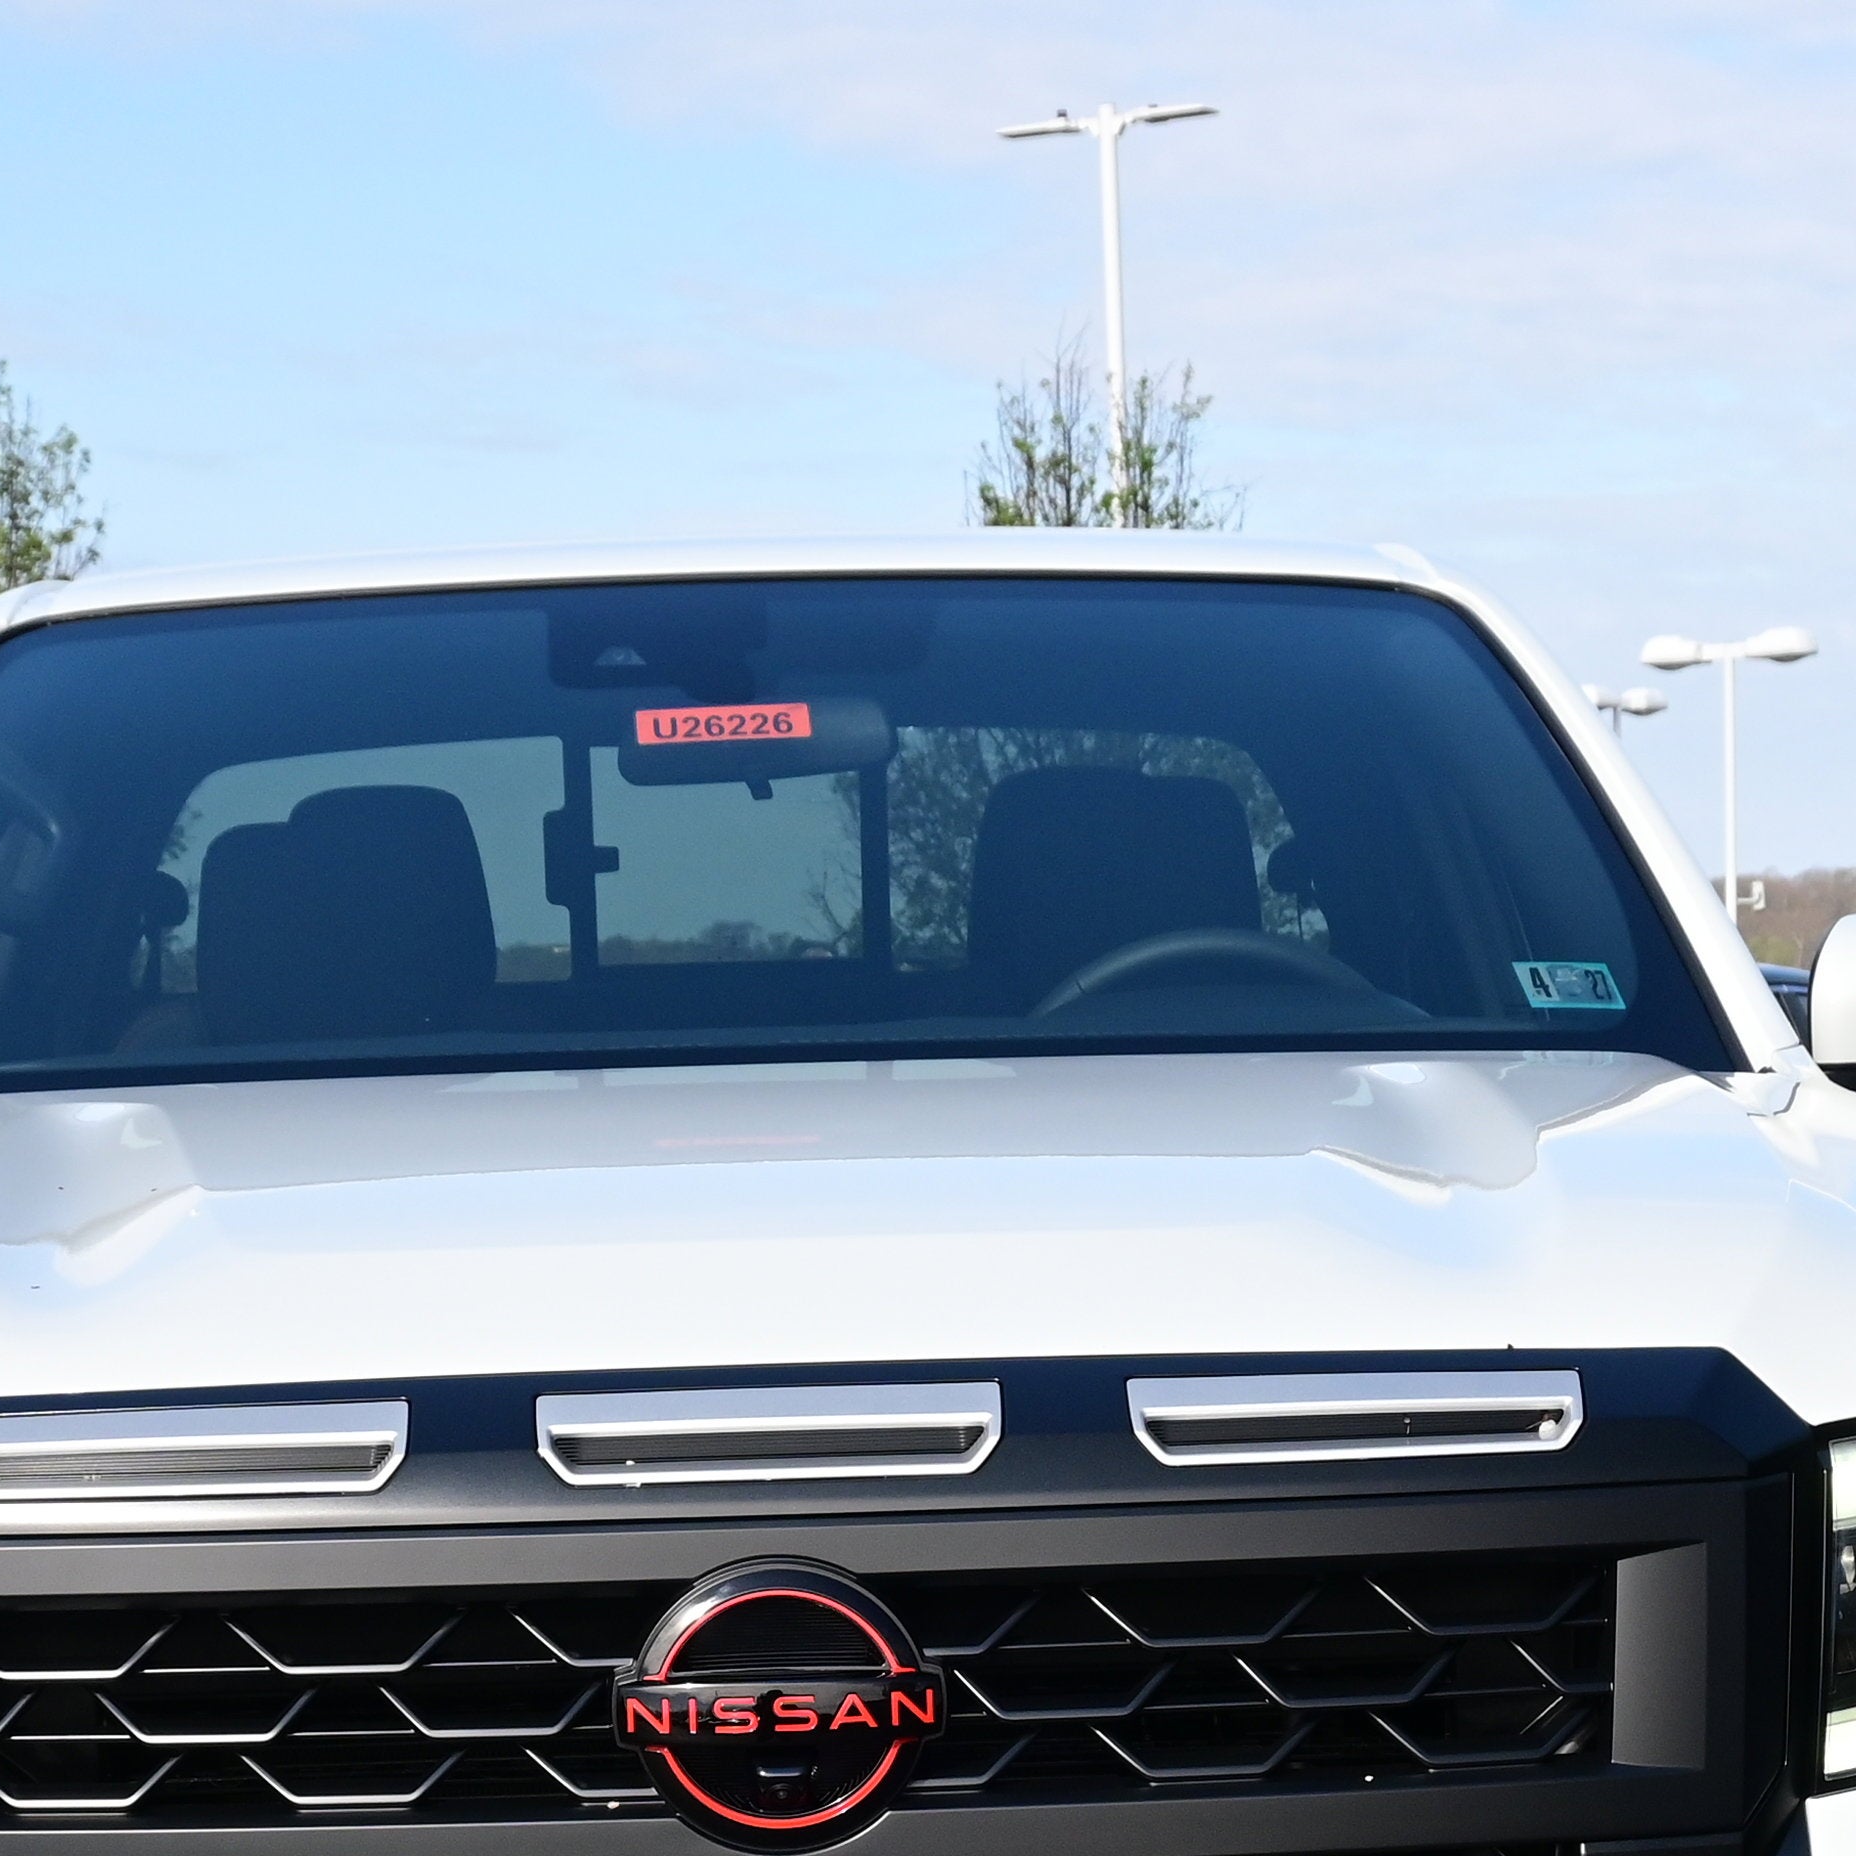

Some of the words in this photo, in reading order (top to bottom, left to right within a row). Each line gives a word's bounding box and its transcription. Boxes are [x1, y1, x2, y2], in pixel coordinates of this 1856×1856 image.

[652, 712, 795, 739] U26226
[1528, 966, 1553, 998] 4
[1583, 969, 1612, 1000] 27
[625, 1688, 935, 1735] NISSAN
